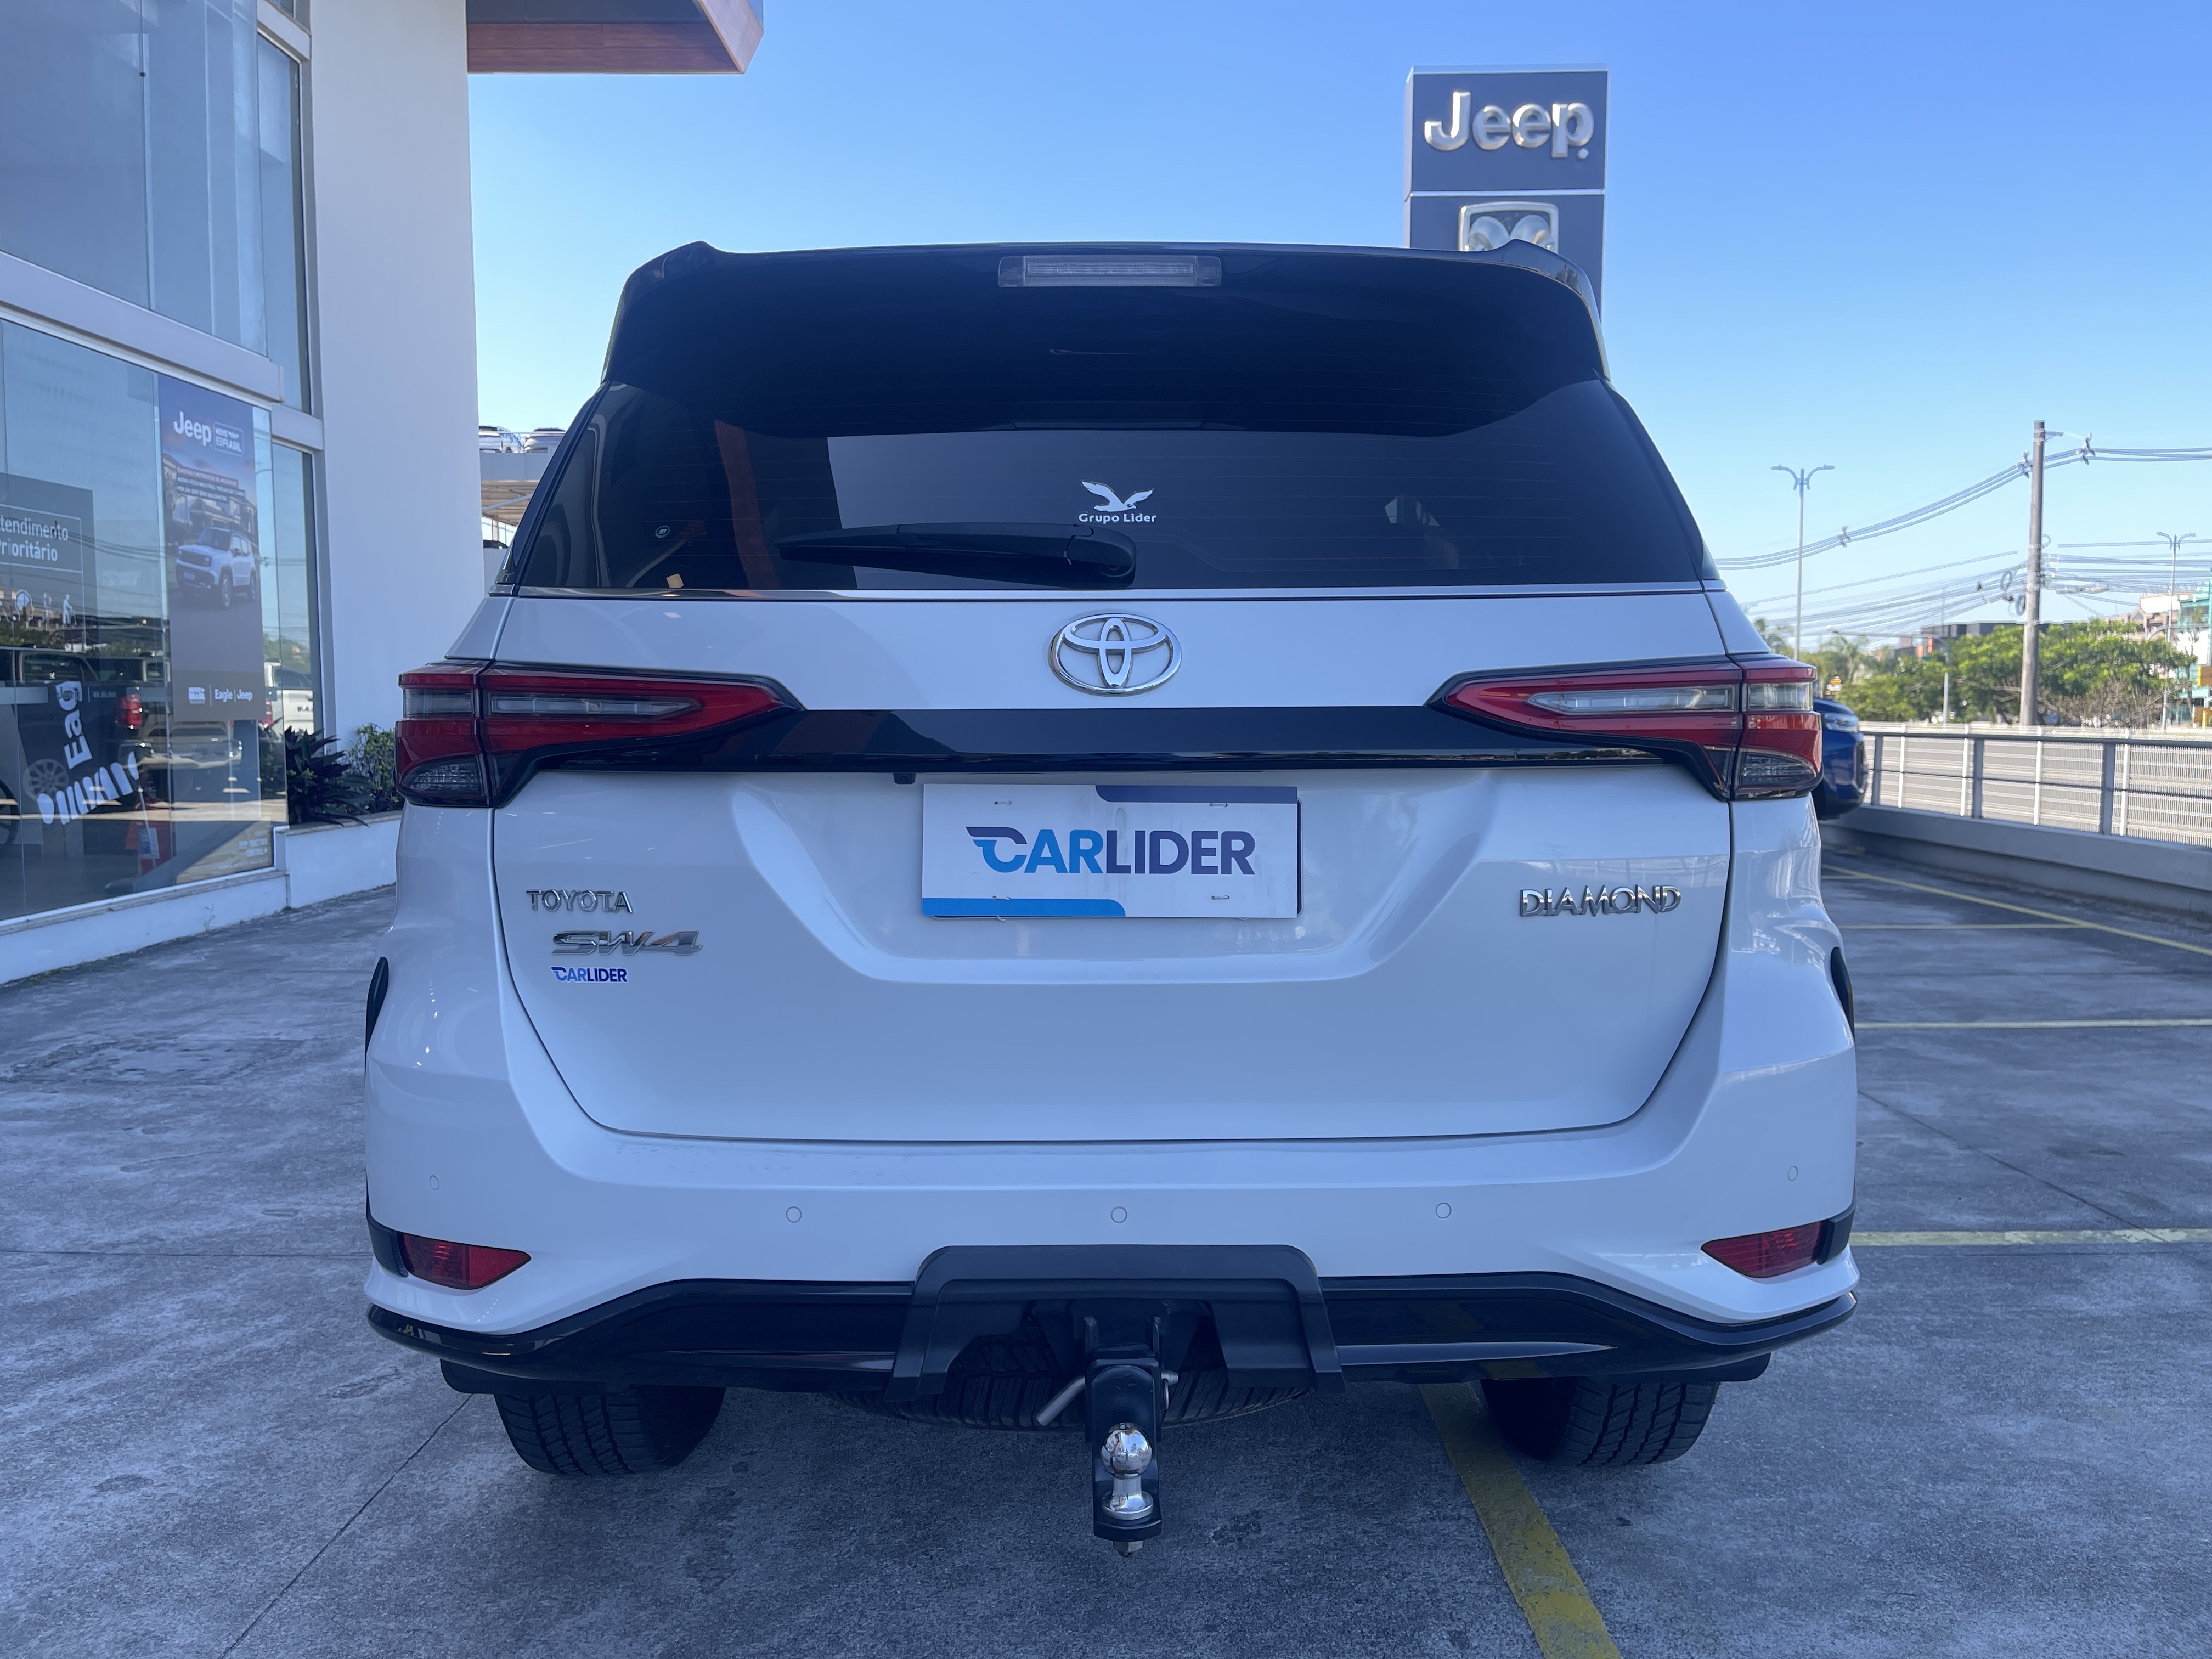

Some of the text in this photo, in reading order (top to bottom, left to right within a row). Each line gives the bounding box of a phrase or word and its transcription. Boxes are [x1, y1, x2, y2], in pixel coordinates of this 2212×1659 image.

[1424, 91, 1594, 159] Jeep
[173, 410, 212, 447] Jeep
[216, 437, 242, 453] BRASIL
[0, 515, 69, 541] tendimento
[1078, 513, 1157, 524] Grupo Lider
[0, 538, 58, 562] rioritário
[214, 688, 233, 703] Eagle
[236, 689, 253, 703] Jeep
[965, 826, 1255, 876] CARLIDER
[526, 889, 633, 913] TOYOTA
[1519, 884, 1682, 917] DIAMOND
[551, 930, 703, 956] SW4
[550, 967, 628, 983] CARLIDER
